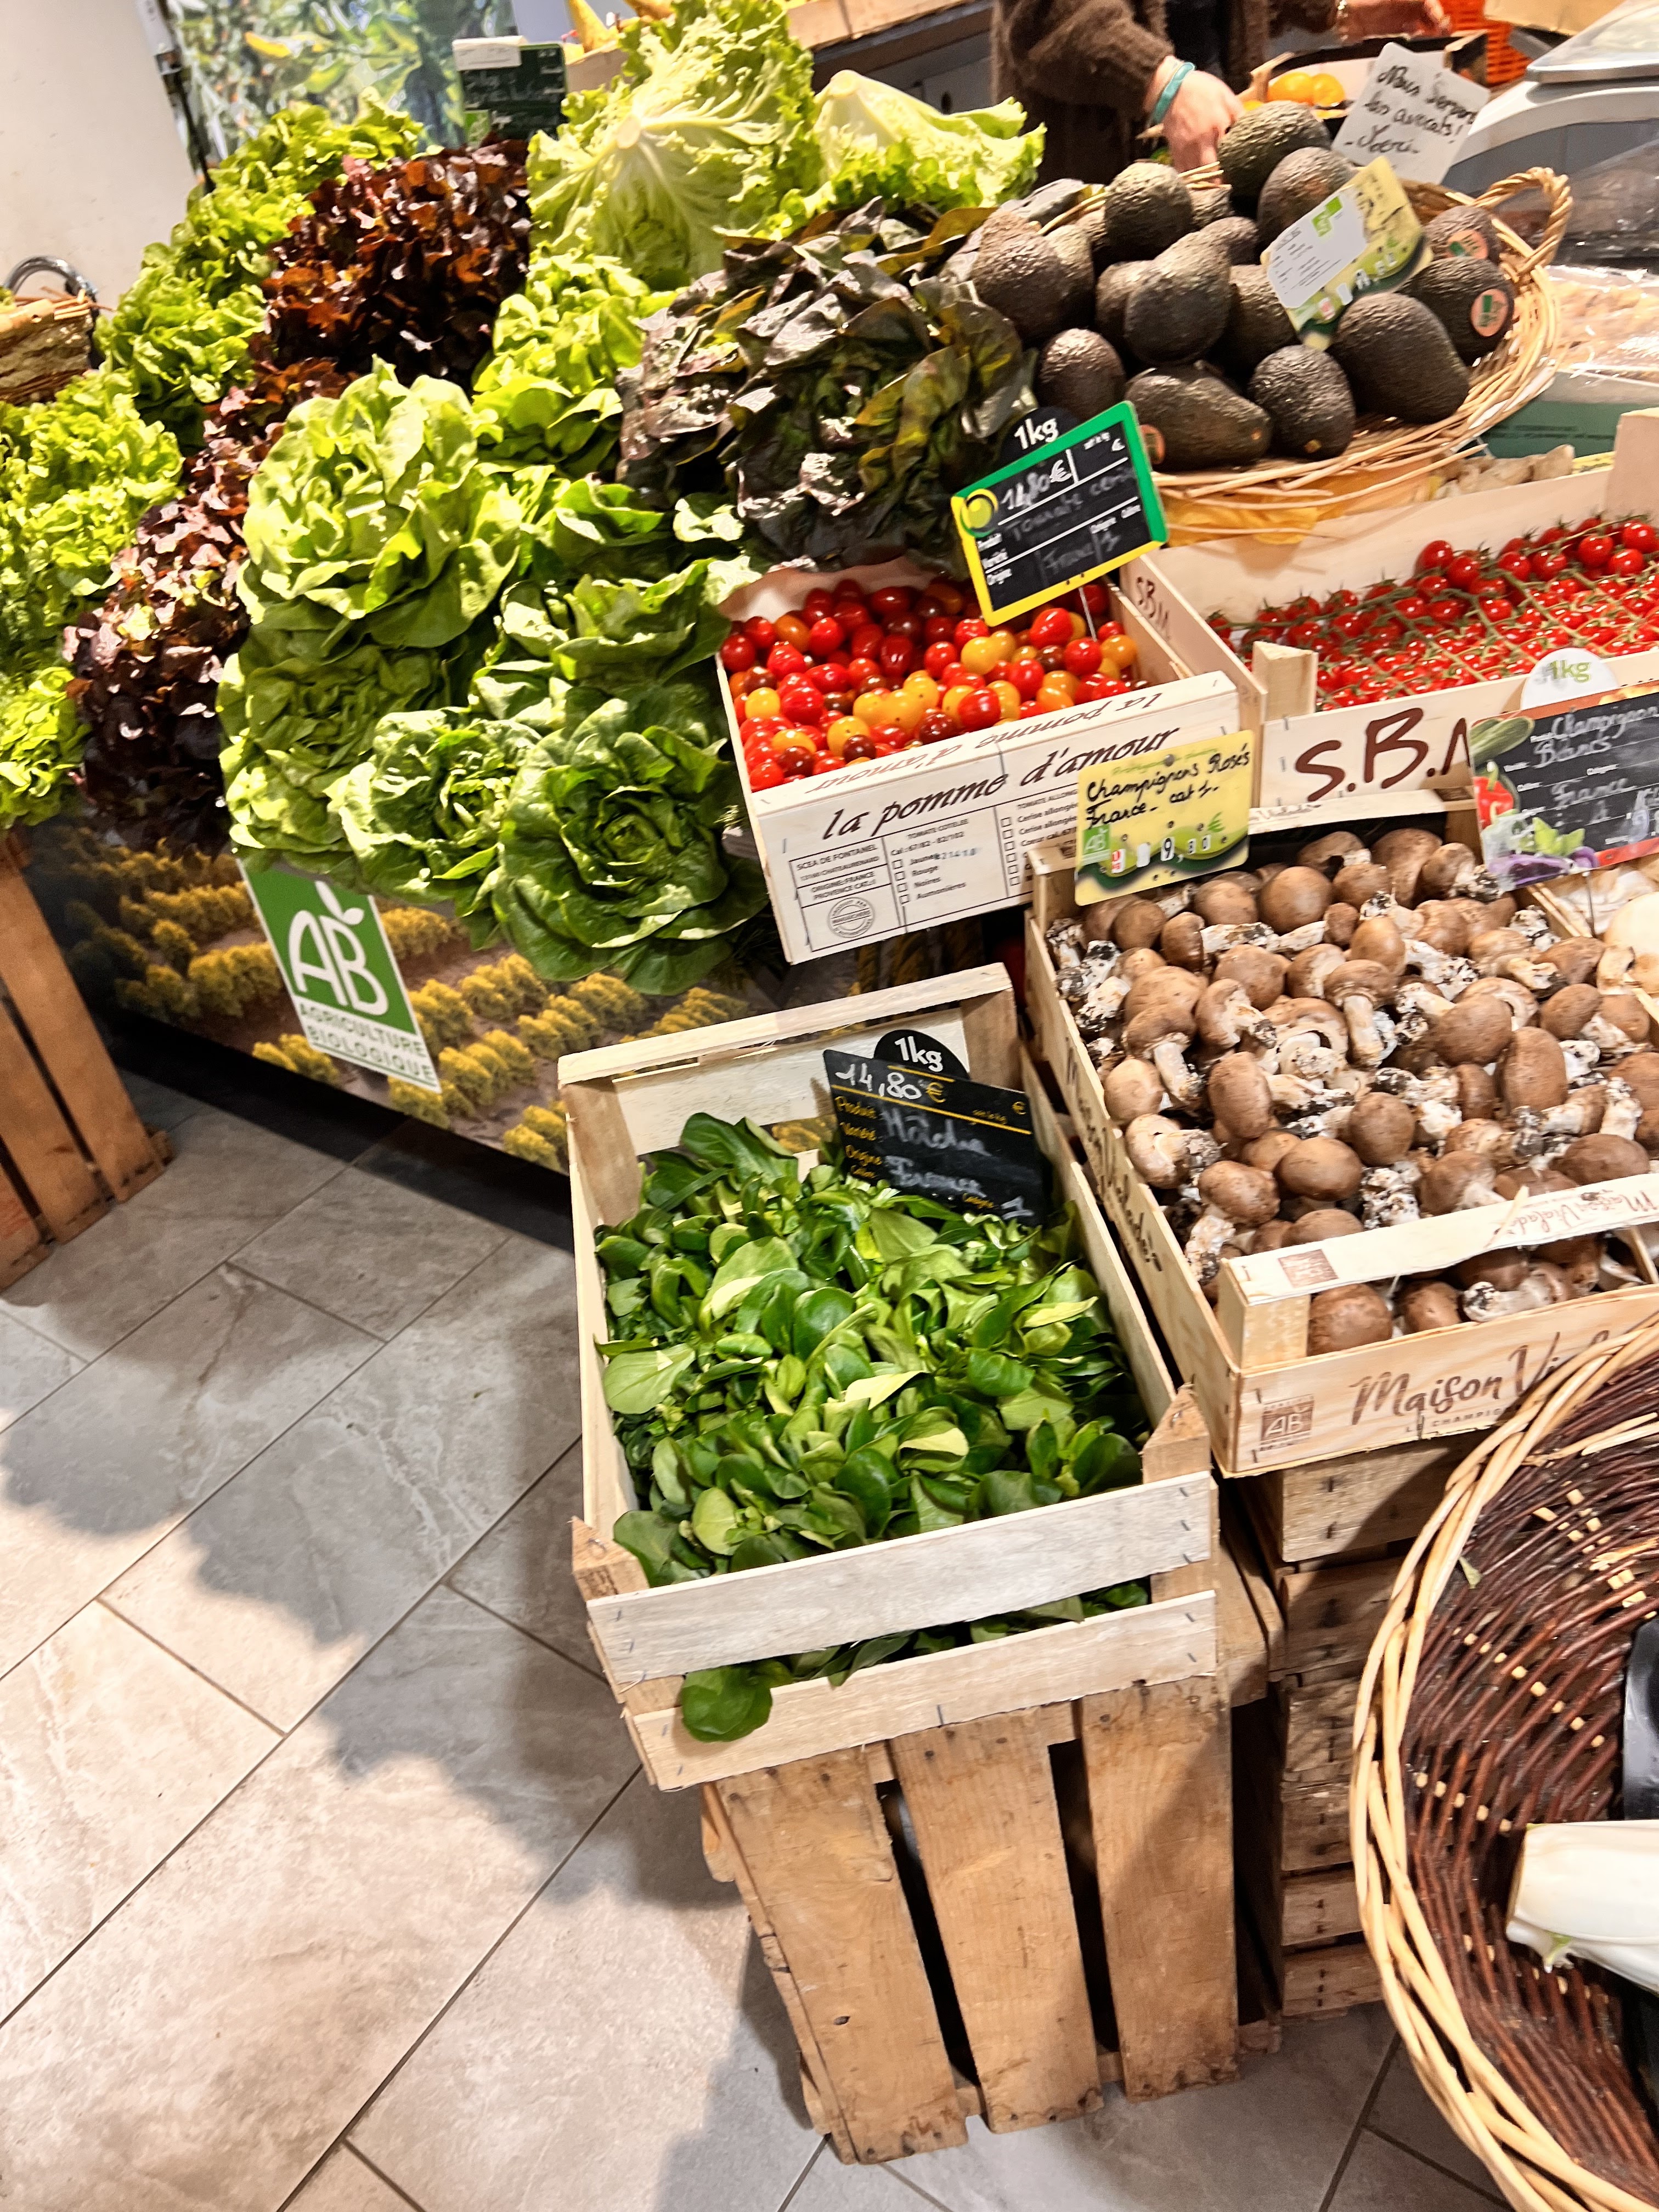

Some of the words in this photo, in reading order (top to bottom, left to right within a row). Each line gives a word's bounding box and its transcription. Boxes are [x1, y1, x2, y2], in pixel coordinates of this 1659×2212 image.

[1014, 418, 1058, 450] 1kg
[1549, 660, 1592, 684] 1kg
[823, 809, 869, 840] la
[870, 772, 1009, 837] pomme
[1020, 728, 1180, 787] d'amour
[820, 856, 831, 865] DE
[289, 910, 388, 1015] AB
[300, 1003, 427, 1058] AGRICULTURE
[307, 1025, 435, 1081] BIOLOGIQUE
[894, 1036, 944, 1073] 1kg
[1349, 1371, 1503, 1428] Maison
